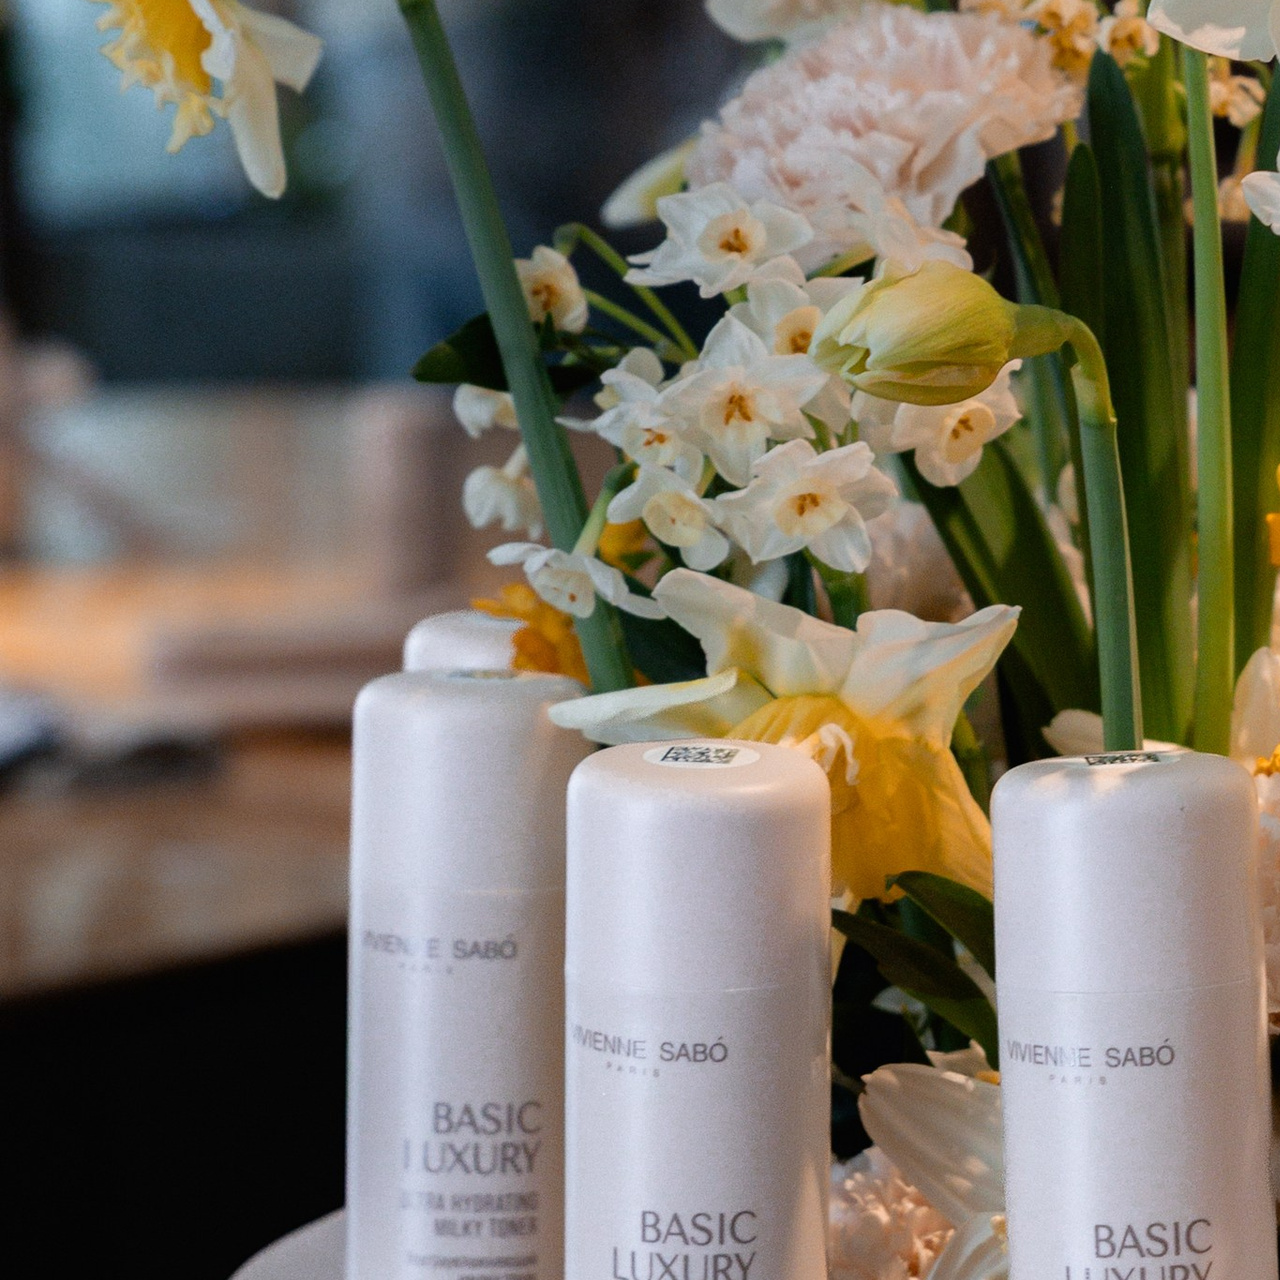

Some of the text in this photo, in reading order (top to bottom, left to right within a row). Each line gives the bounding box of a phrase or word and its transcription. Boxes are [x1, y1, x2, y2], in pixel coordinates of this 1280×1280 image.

[453, 933, 517, 960] SABÓ
[659, 1035, 728, 1063] SABÓ
[1105, 1037, 1175, 1068] SABÓ
[433, 1100, 542, 1136] BASIC
[641, 1210, 757, 1246] BASIC
[1095, 1219, 1213, 1259] BASIC
